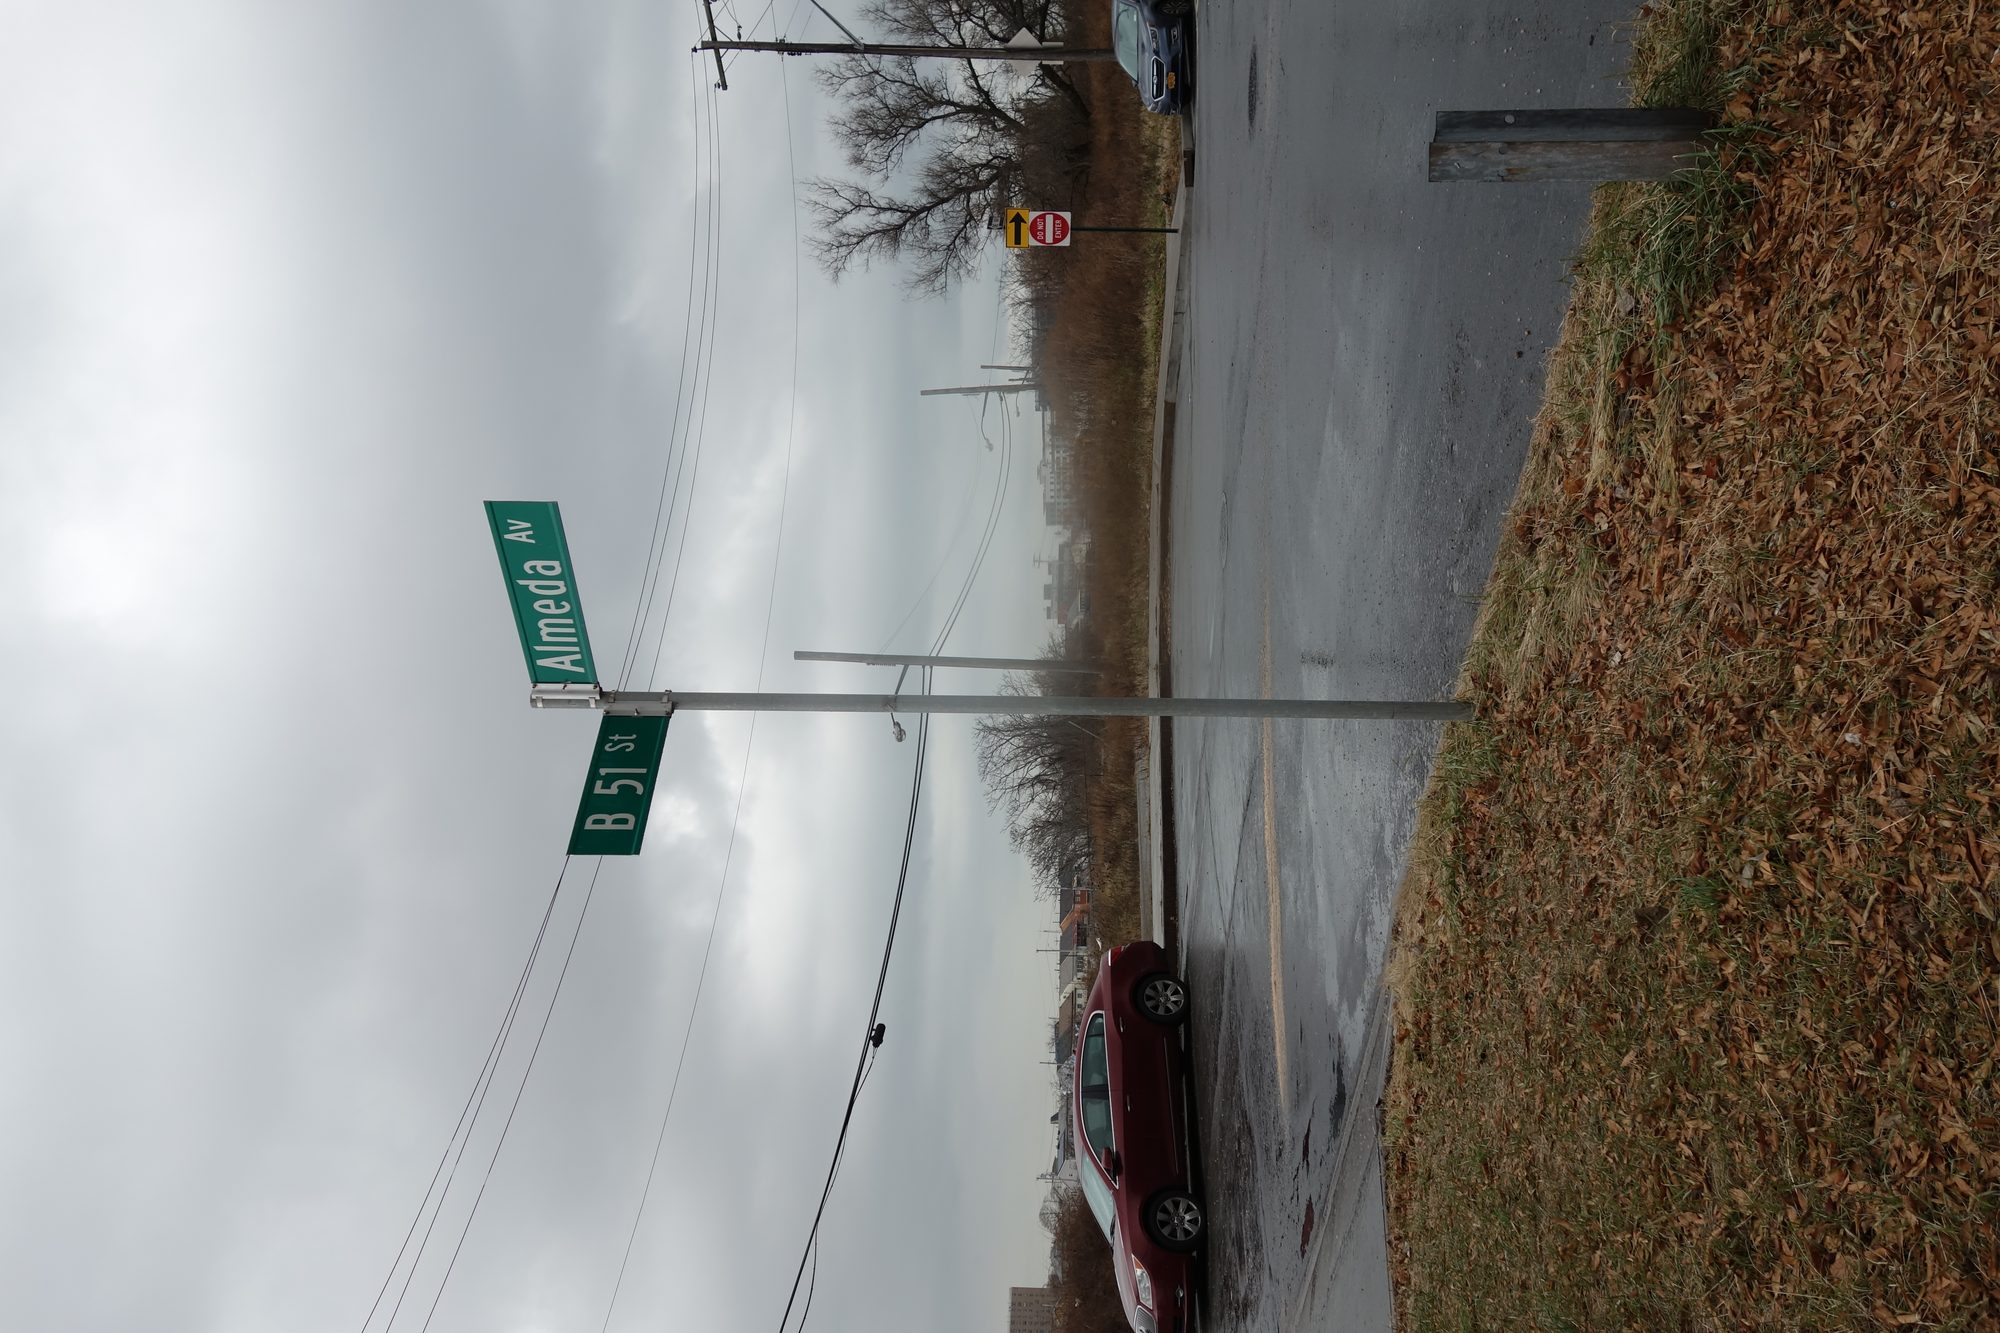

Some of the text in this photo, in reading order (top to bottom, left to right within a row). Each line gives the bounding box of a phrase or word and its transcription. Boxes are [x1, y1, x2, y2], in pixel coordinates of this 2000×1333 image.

[1037, 231, 1044, 239] DO
[515, 560, 585, 673] Almeda
[583, 734, 648, 830] B 51 St
